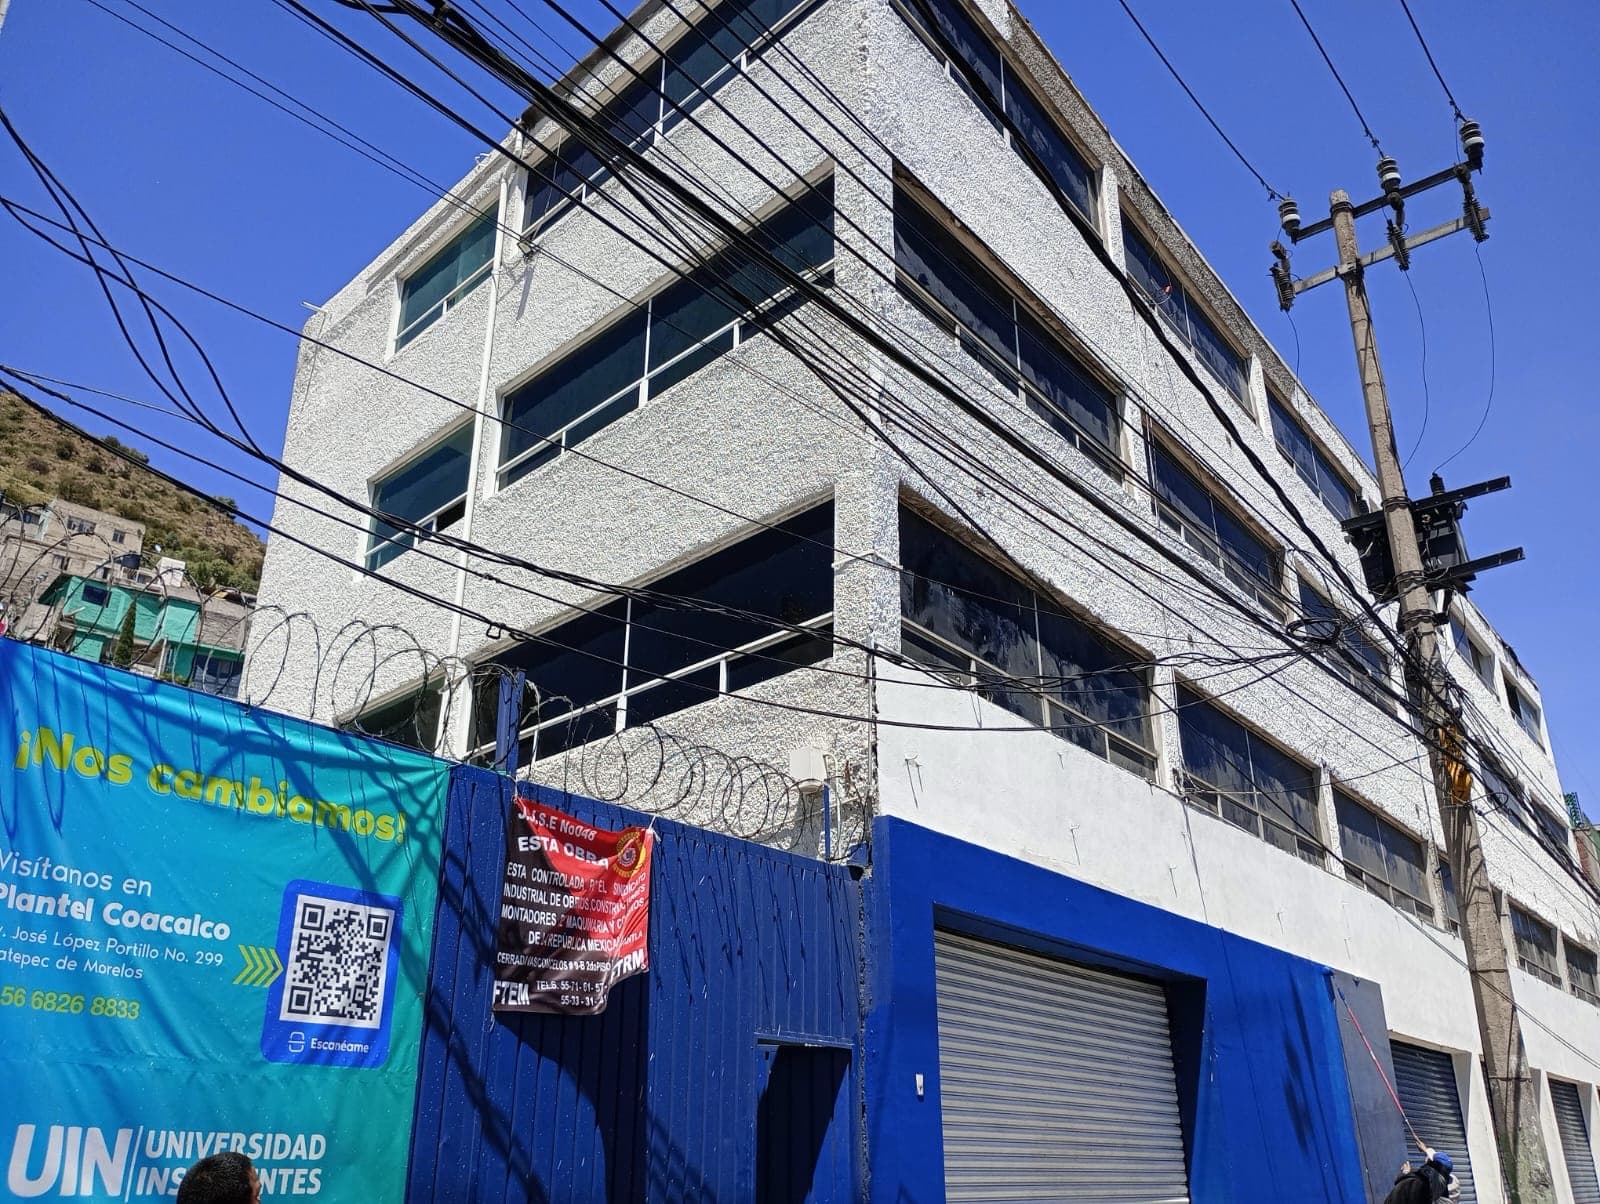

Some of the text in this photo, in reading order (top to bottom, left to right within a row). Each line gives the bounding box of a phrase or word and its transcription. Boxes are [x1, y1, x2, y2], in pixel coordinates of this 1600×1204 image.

[148, 763, 407, 844] cambiamos!
[517, 836, 609, 870] ESTA OBRA
[0, 848, 152, 897] Visítanos en
[507, 862, 527, 879] ESTA
[531, 867, 585, 889] CONTROLADA
[503, 882, 548, 904] INDUSTRIAL
[550, 889, 562, 907] DE
[0, 882, 231, 941] Plantel Coacalco
[501, 903, 557, 927] MONTADORES
[12, 926, 48, 945] José
[53, 931, 101, 952] López
[106, 937, 159, 960] Portillo
[164, 947, 189, 963] No.
[194, 950, 224, 967] 299
[528, 930, 540, 945] DE
[56, 956, 78, 971] de
[83, 959, 144, 980] Morelos
[1, 984, 141, 1020] 56 6826 8833
[493, 981, 530, 1006] FTEM
[310, 1037, 369, 1054] Escanéame
[7, 1123, 134, 1198] UIN
[145, 1130, 327, 1161] UNIVERSIDAD
[136, 1166, 322, 1196] INSNTES
